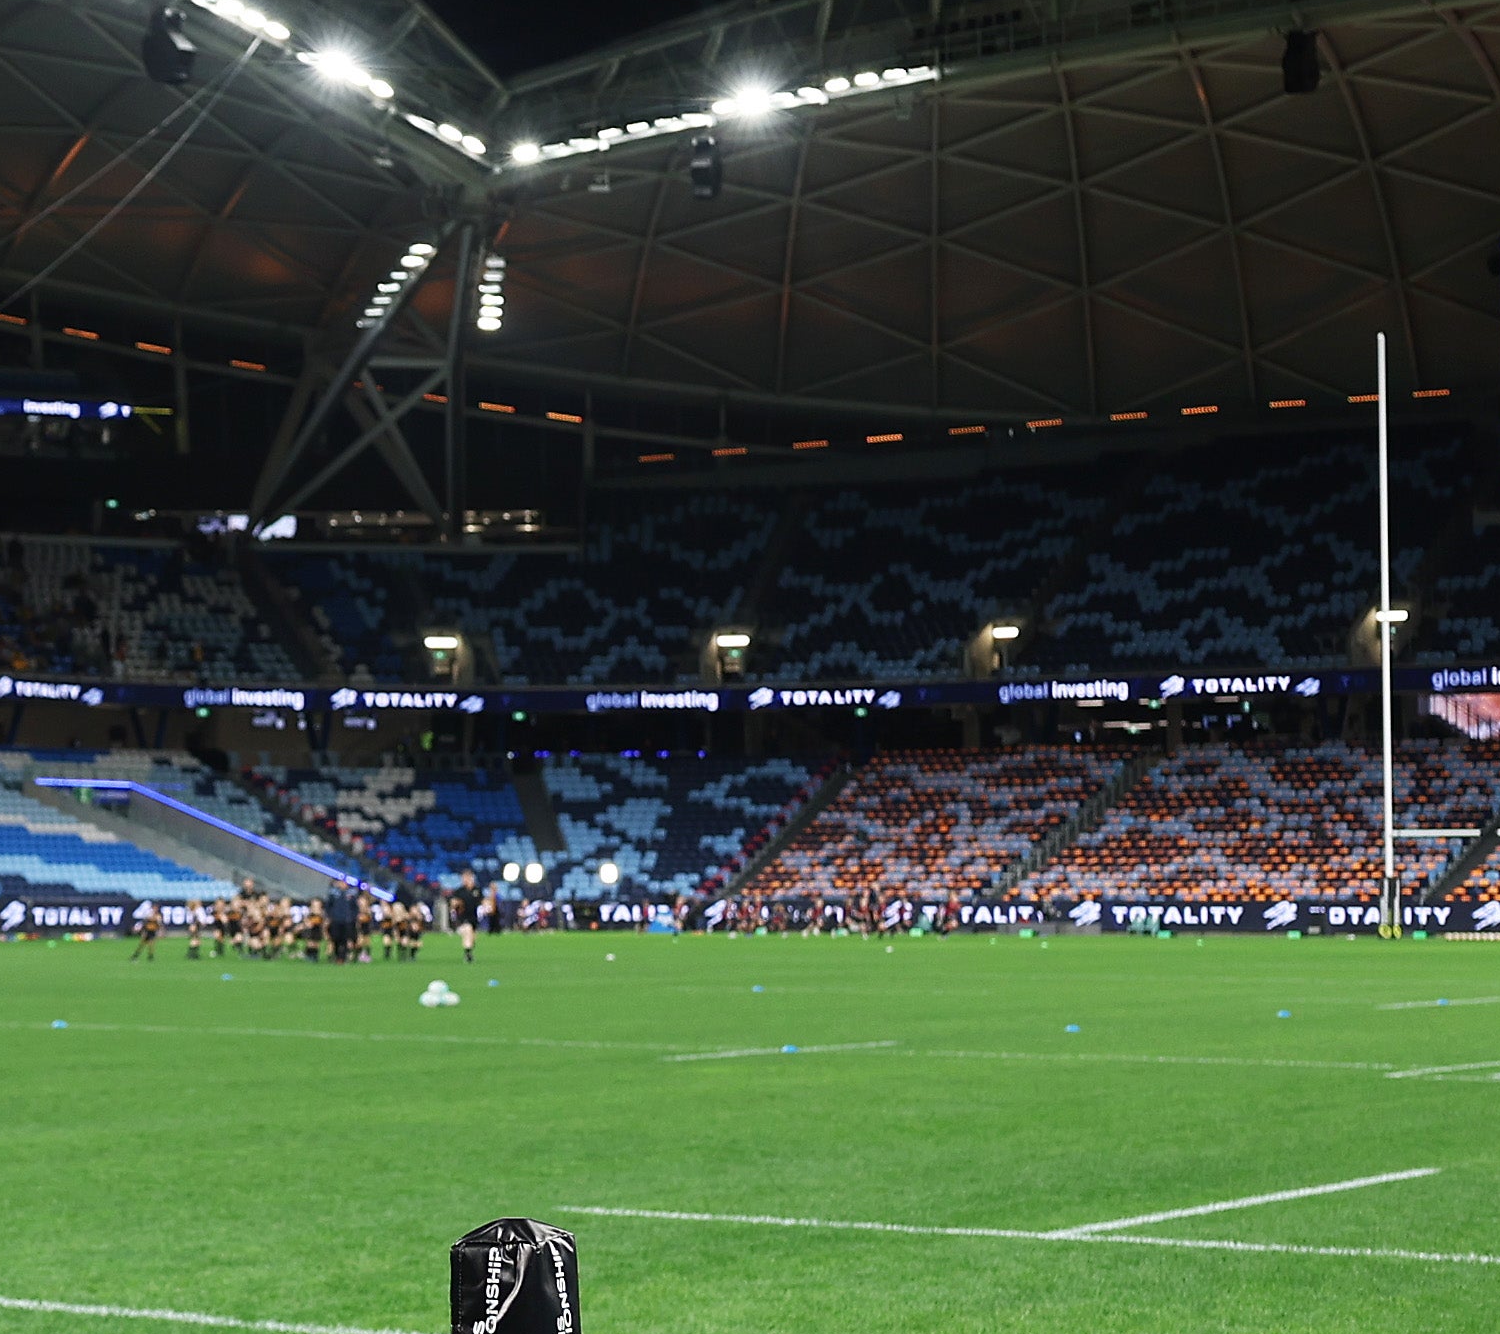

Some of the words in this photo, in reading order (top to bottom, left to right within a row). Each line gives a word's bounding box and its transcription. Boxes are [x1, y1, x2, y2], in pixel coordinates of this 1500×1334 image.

[1192, 676, 1291, 694] TOTALITY
[1431, 668, 1487, 691] global
[232, 688, 304, 711] investing
[363, 693, 457, 708] TOTALITY
[640, 690, 719, 712] investing
[780, 688, 875, 706] TOTALITY
[999, 682, 1049, 705] global
[1051, 679, 1129, 701] investing
[32, 906, 124, 925] TOTALTY
[921, 906, 1043, 924] TTALIT
[1112, 906, 1243, 925] TOTALITY
[1310, 906, 1450, 925] OTAITY
